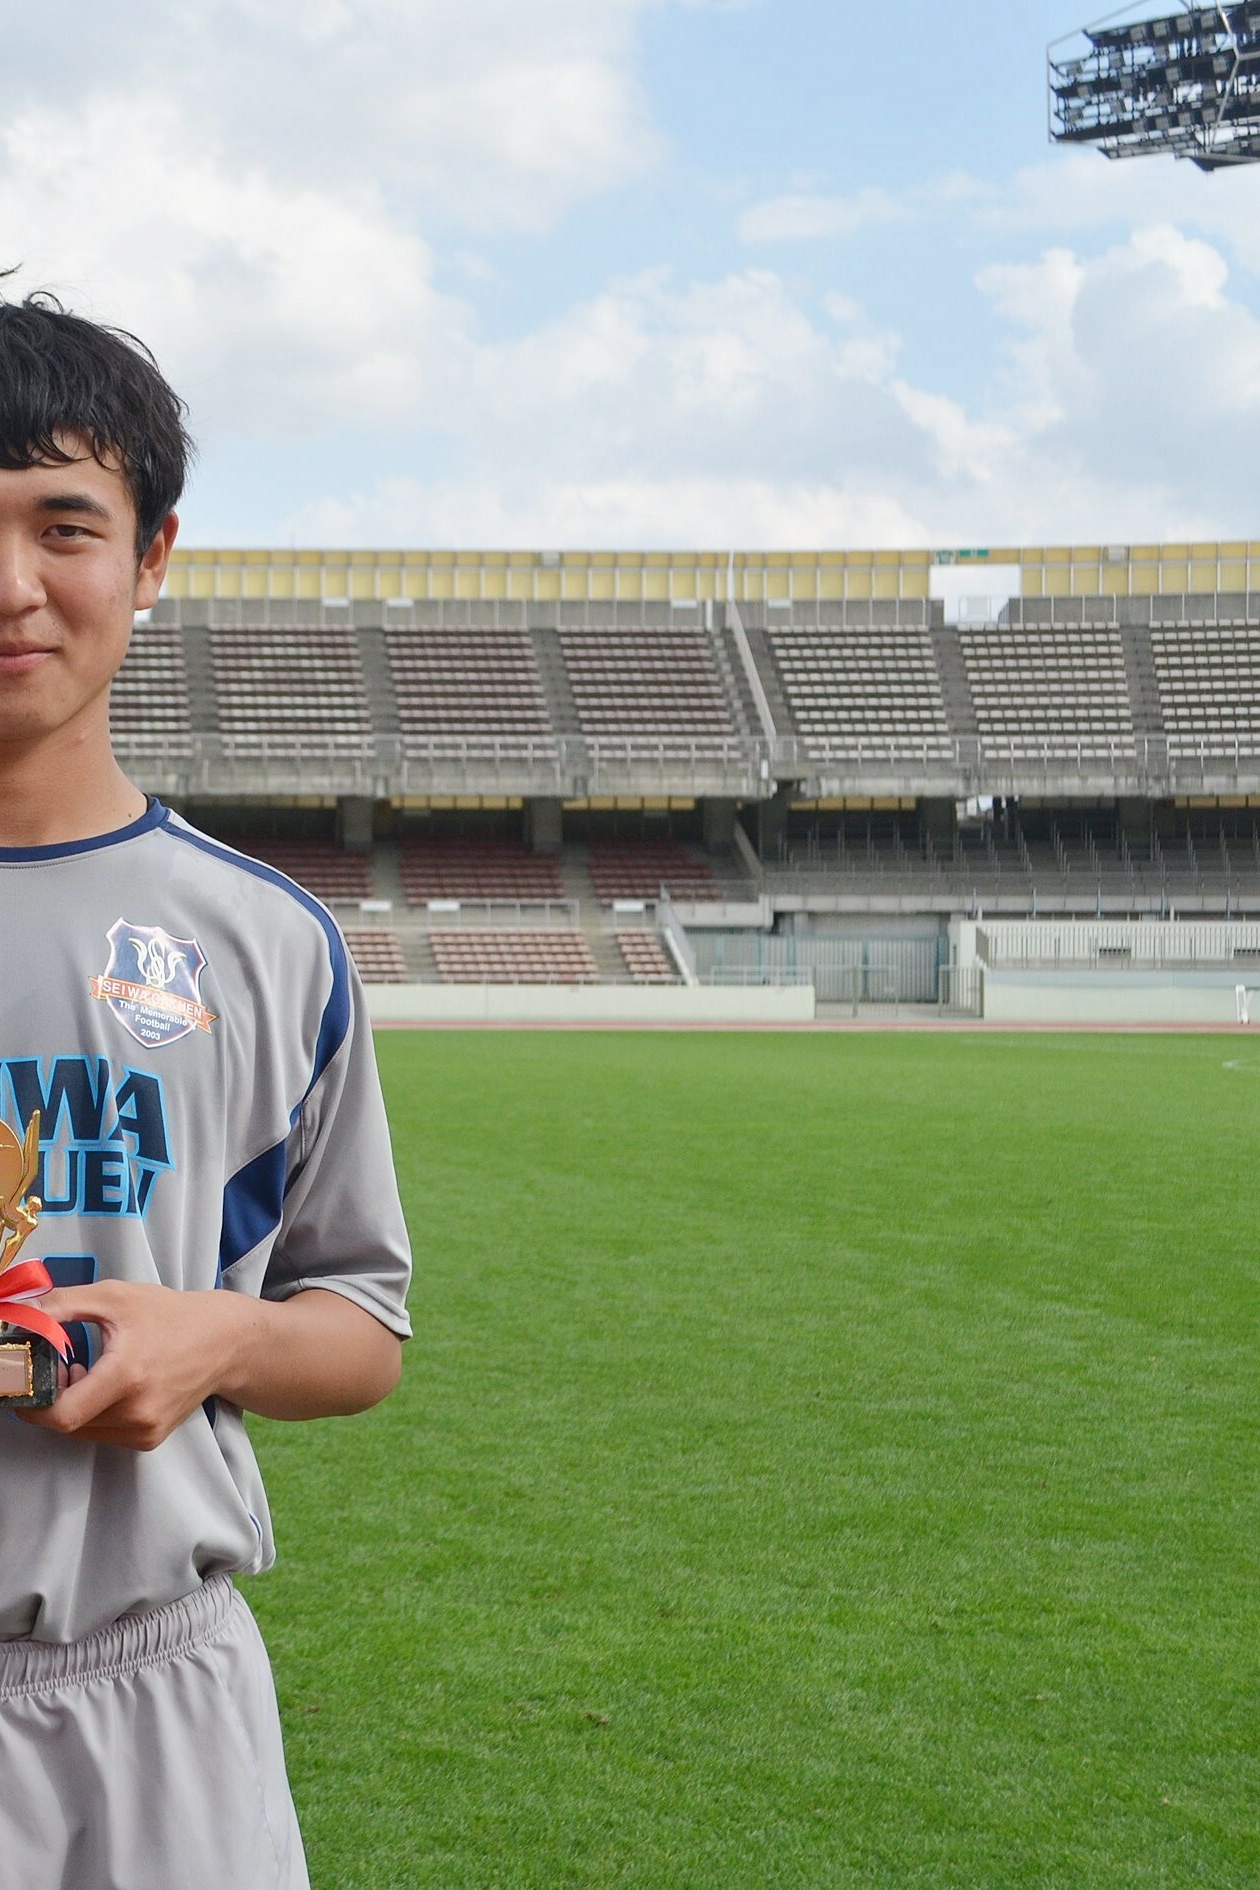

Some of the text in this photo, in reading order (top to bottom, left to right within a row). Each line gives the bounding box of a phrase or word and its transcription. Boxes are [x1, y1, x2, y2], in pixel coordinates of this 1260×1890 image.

[118, 999, 188, 1026] The Memorable
[134, 1014, 171, 1032] Football
[140, 1027, 161, 1041] 2003
